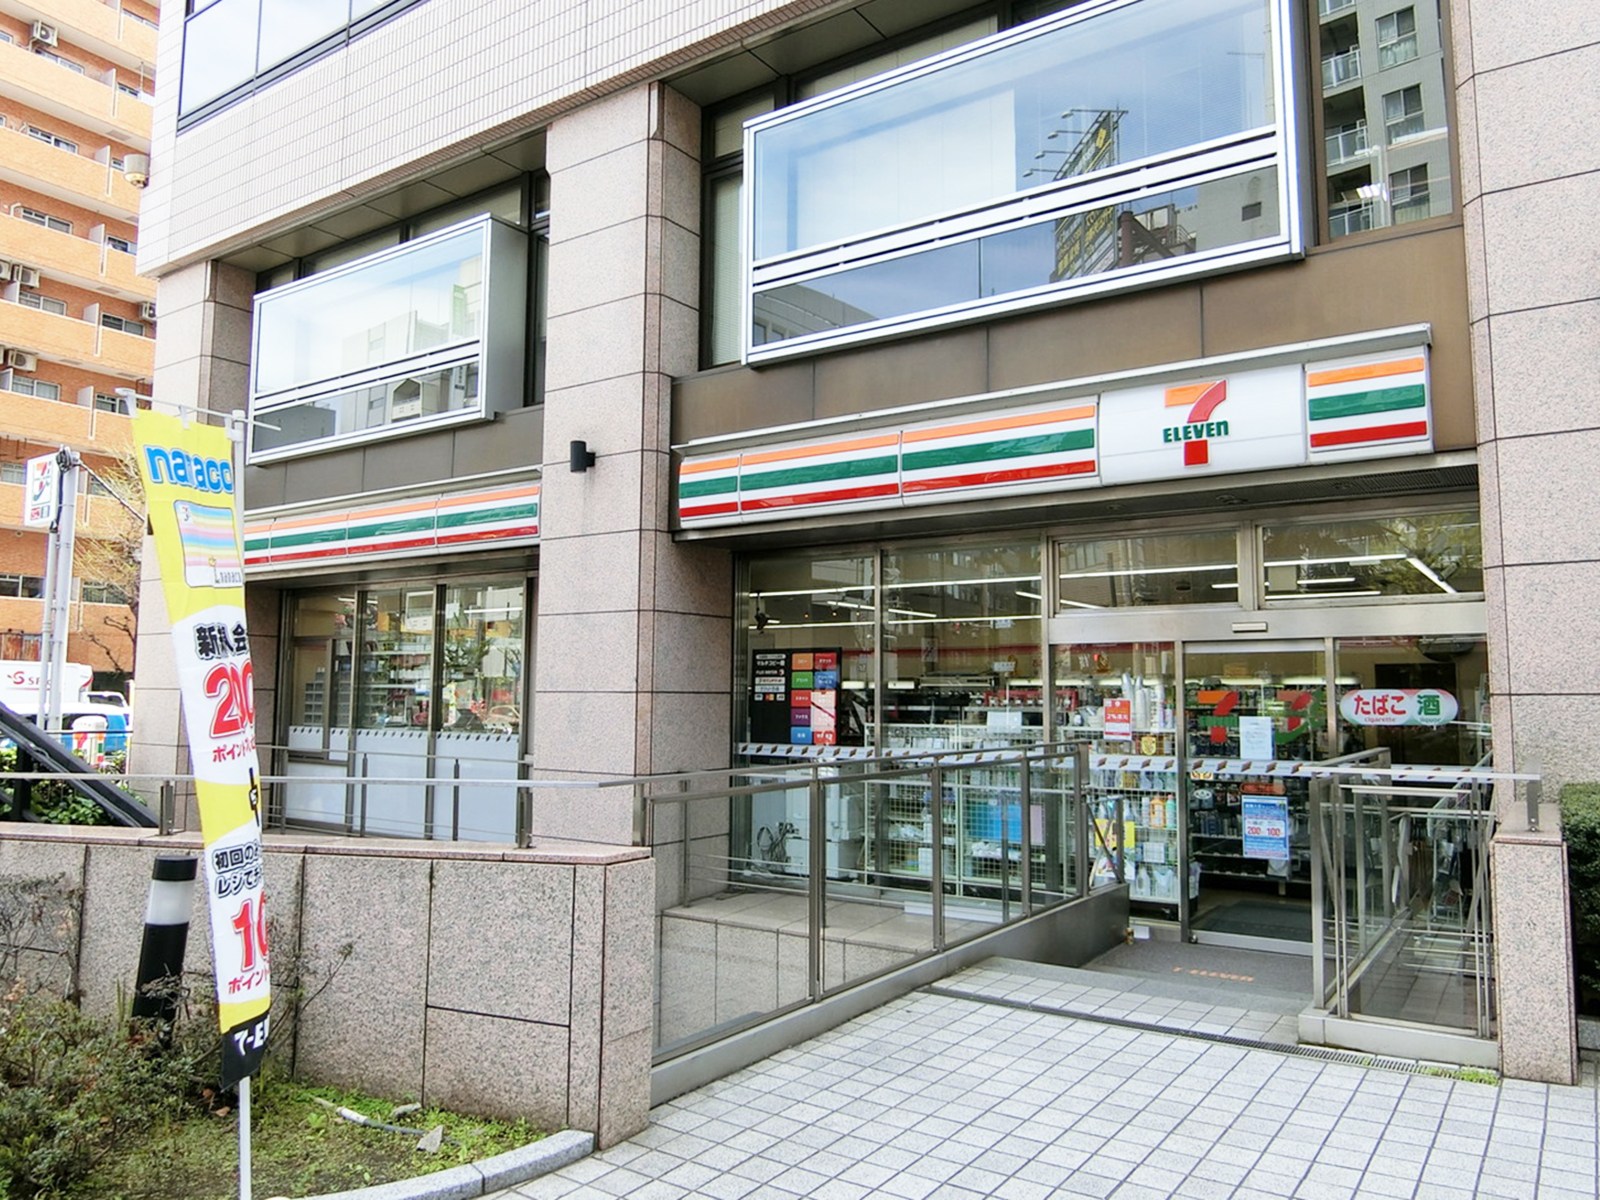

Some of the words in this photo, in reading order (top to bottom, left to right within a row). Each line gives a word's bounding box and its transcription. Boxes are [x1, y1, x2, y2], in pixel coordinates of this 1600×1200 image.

[145, 445, 234, 493] naaco
[1354, 694, 1406, 715] たばこ
[1416, 694, 1441, 716] 酒
